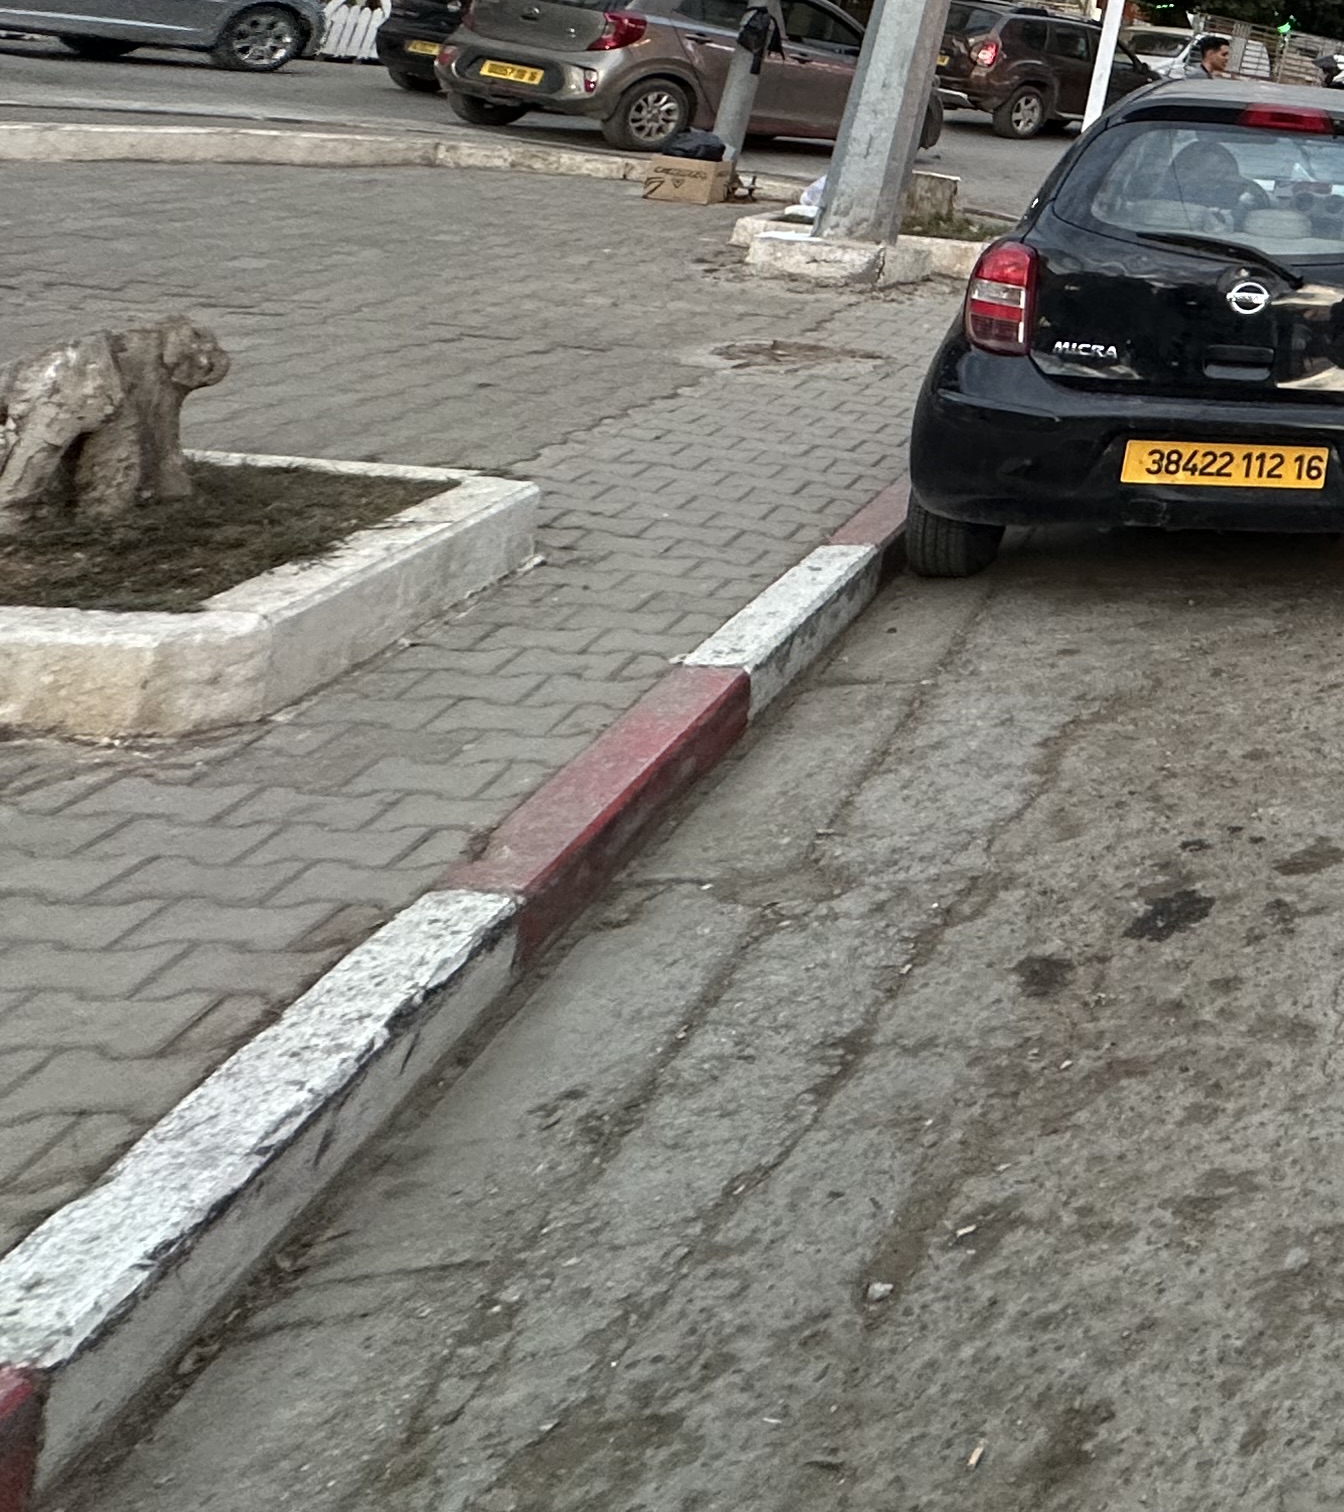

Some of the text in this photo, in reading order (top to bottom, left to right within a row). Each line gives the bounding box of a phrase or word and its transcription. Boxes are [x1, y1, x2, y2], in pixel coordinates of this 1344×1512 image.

[1053, 341, 1117, 359] MICRA
[1145, 449, 1323, 480] 38422 112 16
